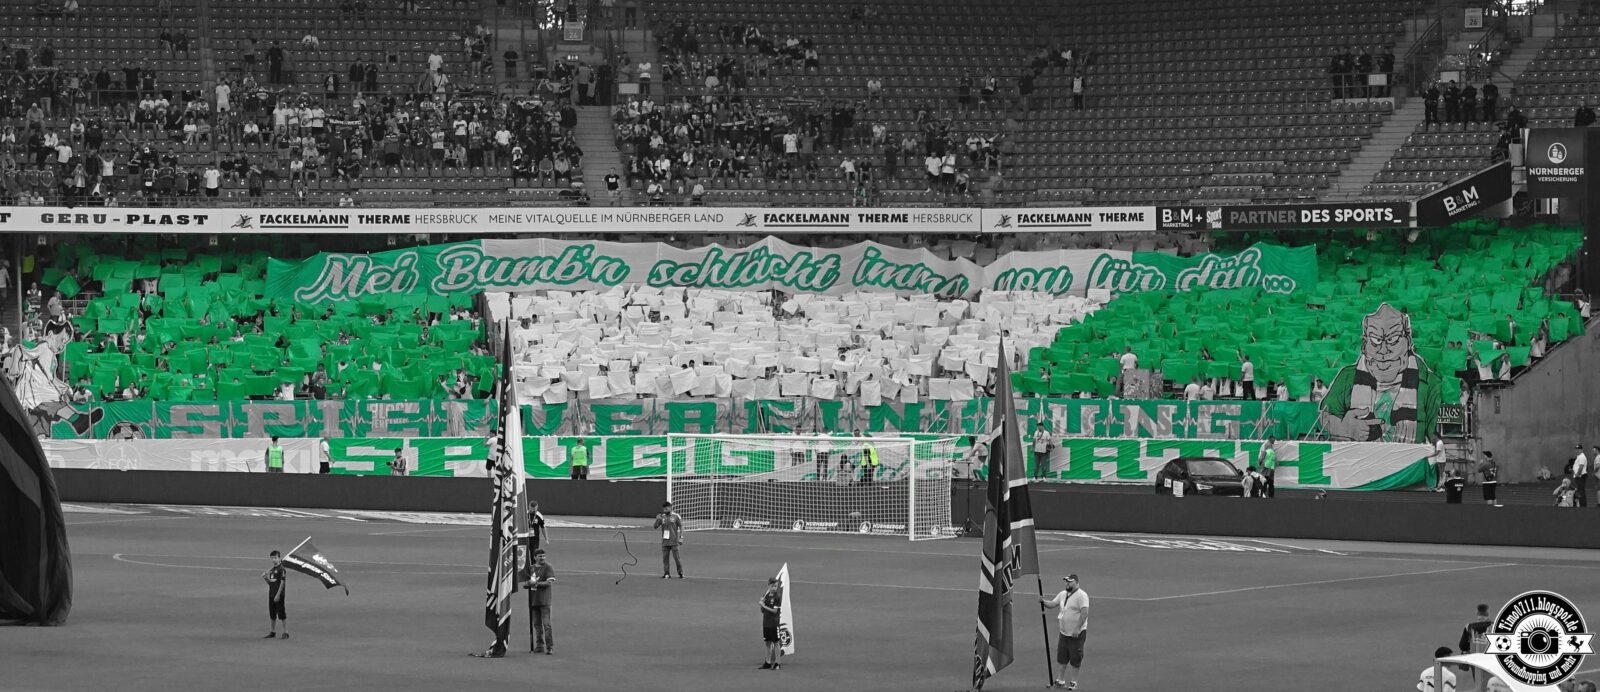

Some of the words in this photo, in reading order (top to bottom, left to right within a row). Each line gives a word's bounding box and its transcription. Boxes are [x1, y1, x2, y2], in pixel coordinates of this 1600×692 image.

[1529, 167, 1584, 176] NÜRNBERGER
[1443, 185, 1480, 211] B&M
[260, 214, 349, 225] FACKELMANN
[358, 214, 411, 225] THERME
[415, 213, 478, 225] HERSBRUCK
[489, 213, 522, 224] MEINE
[525, 213, 597, 225] VITALQUELLE
[601, 213, 613, 223] IM
[616, 211, 691, 223] NÜRNBERGER
[694, 213, 724, 223] LAND
[764, 213, 850, 223] FACKELMANN
[858, 213, 909, 223] THERME
[913, 213, 973, 224] HERSBRUCK
[1017, 213, 1092, 223] FACKELMANN
[1099, 212, 1145, 222] THERME
[1162, 208, 1194, 222] B&M
[1231, 210, 1297, 224] PARTNER
[1301, 210, 1331, 223] DES
[294, 251, 419, 304] Mei
